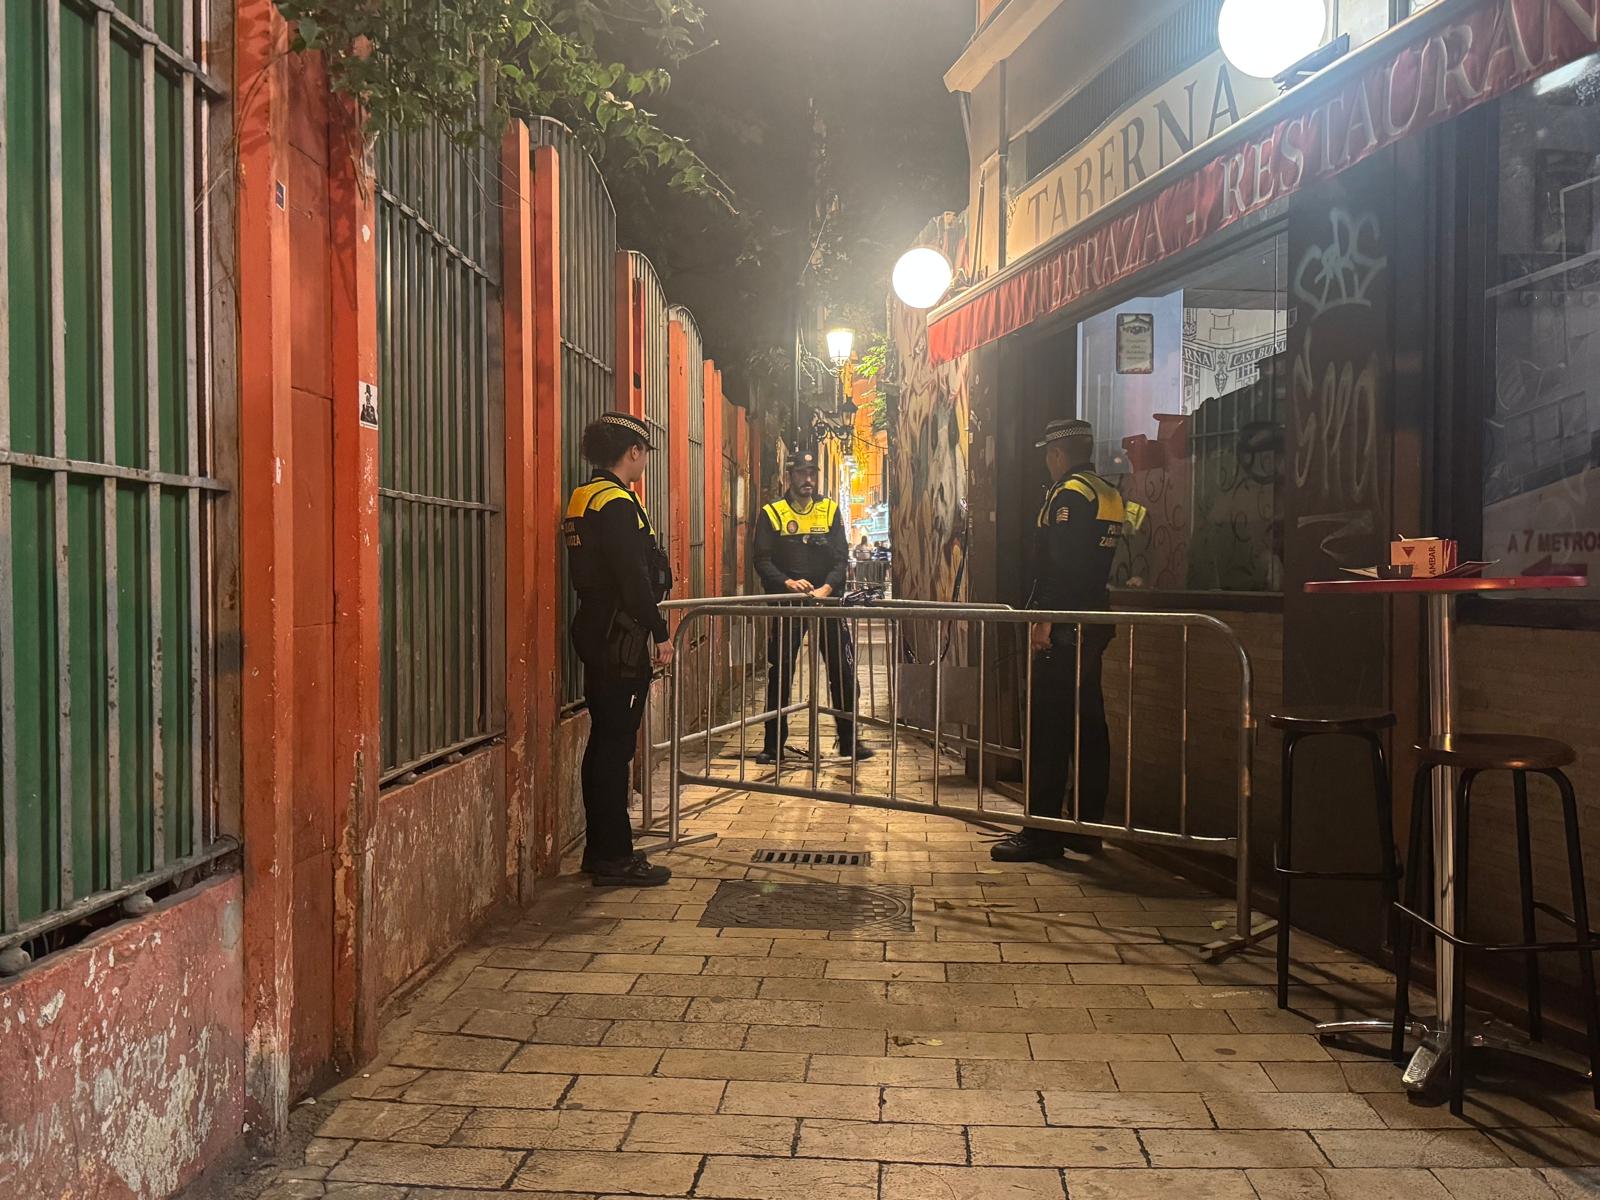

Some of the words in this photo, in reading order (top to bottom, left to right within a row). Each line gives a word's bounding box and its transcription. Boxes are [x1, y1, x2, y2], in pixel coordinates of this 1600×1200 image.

[1027, 62, 1241, 243] TABERNA
[1035, 199, 1167, 313] TERRAZA
[1233, 350, 1257, 367] CASA
[1507, 532, 1519, 554] A
[1523, 527, 1535, 553] 7
[1537, 530, 1600, 553] METRO
[1428, 545, 1437, 576] AMBAR
